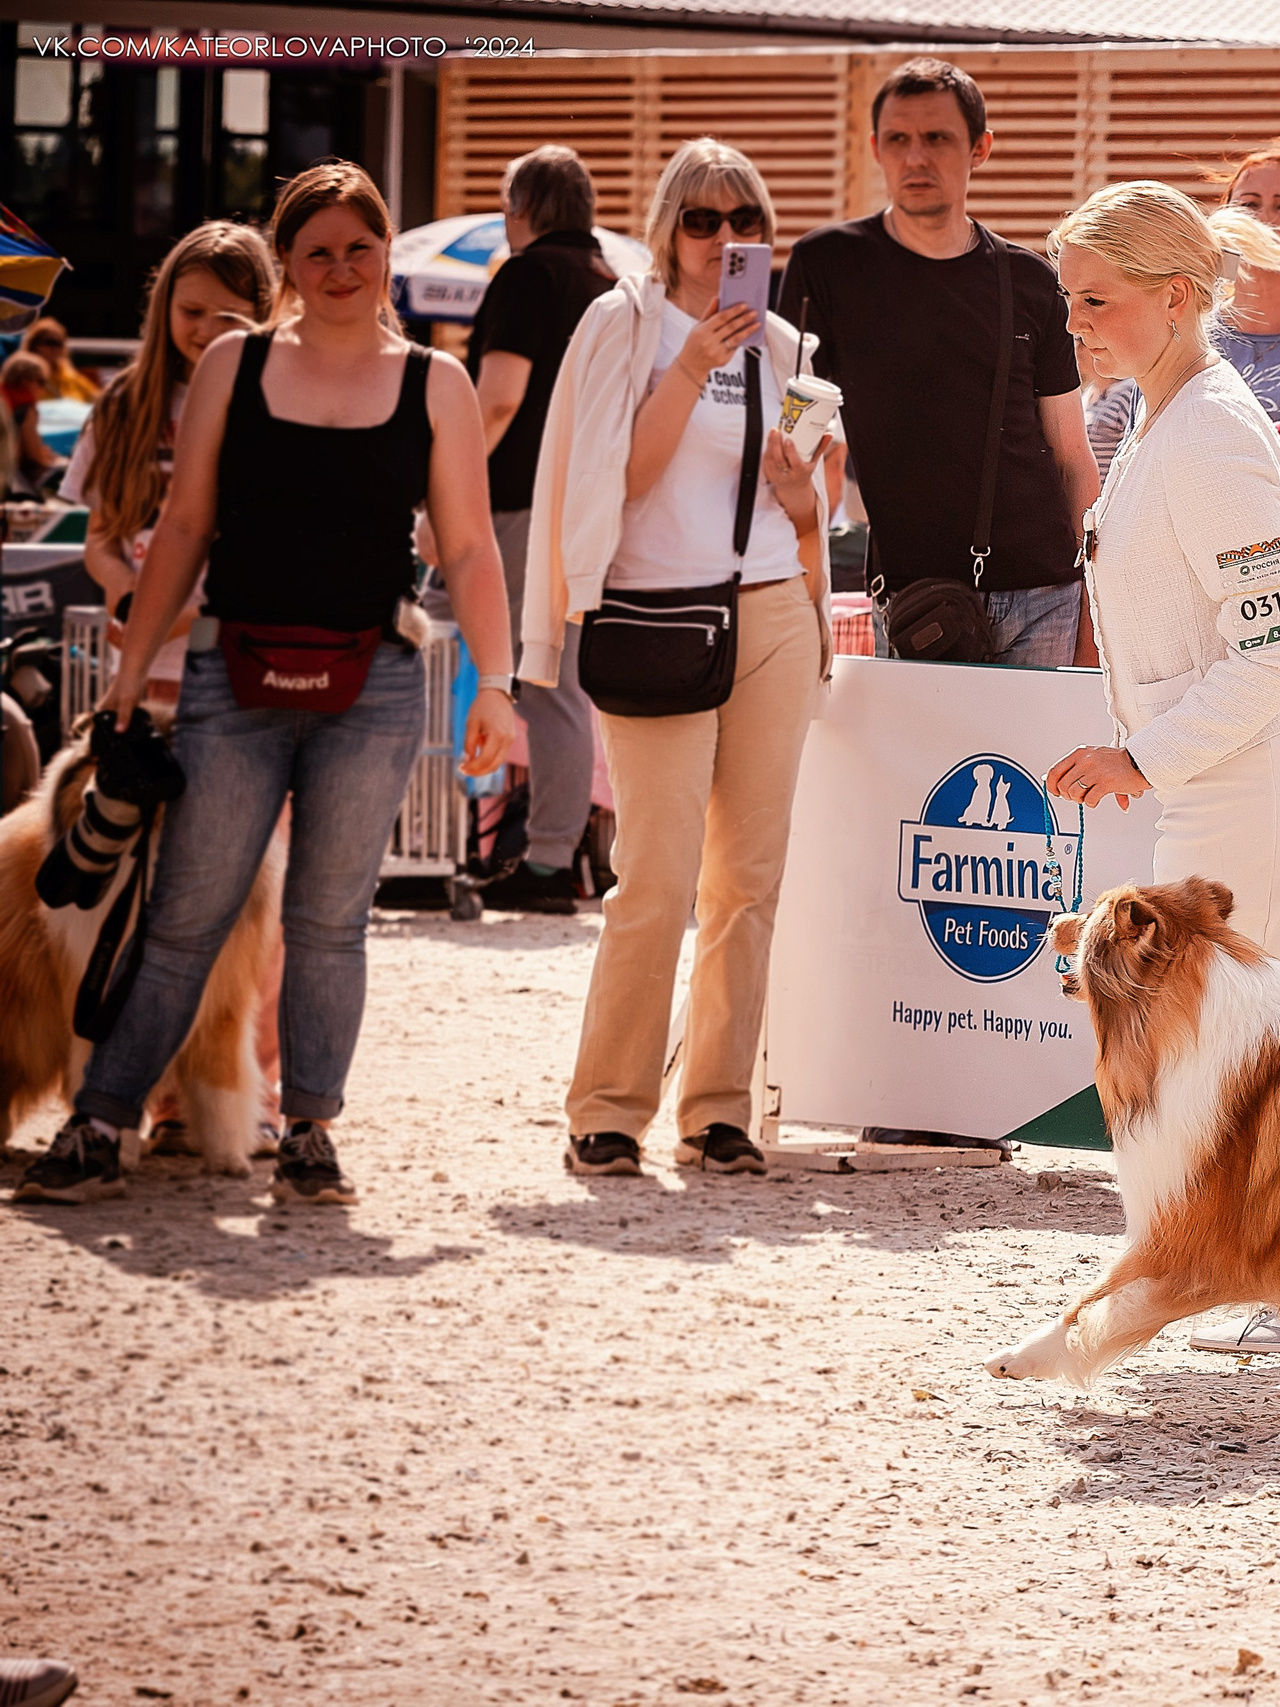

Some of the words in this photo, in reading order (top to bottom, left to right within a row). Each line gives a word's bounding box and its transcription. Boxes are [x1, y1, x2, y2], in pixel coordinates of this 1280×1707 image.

[1251, 559, 1280, 572] РОССИЯ
[262, 670, 330, 690] Award
[911, 833, 1062, 901] Farmina
[943, 918, 972, 946] Pet
[978, 920, 1029, 951] Foods
[892, 1000, 942, 1033] Happy
[947, 1009, 978, 1034] pet.
[983, 1009, 1032, 1041] Happy
[1039, 1020, 1073, 1043] you.
